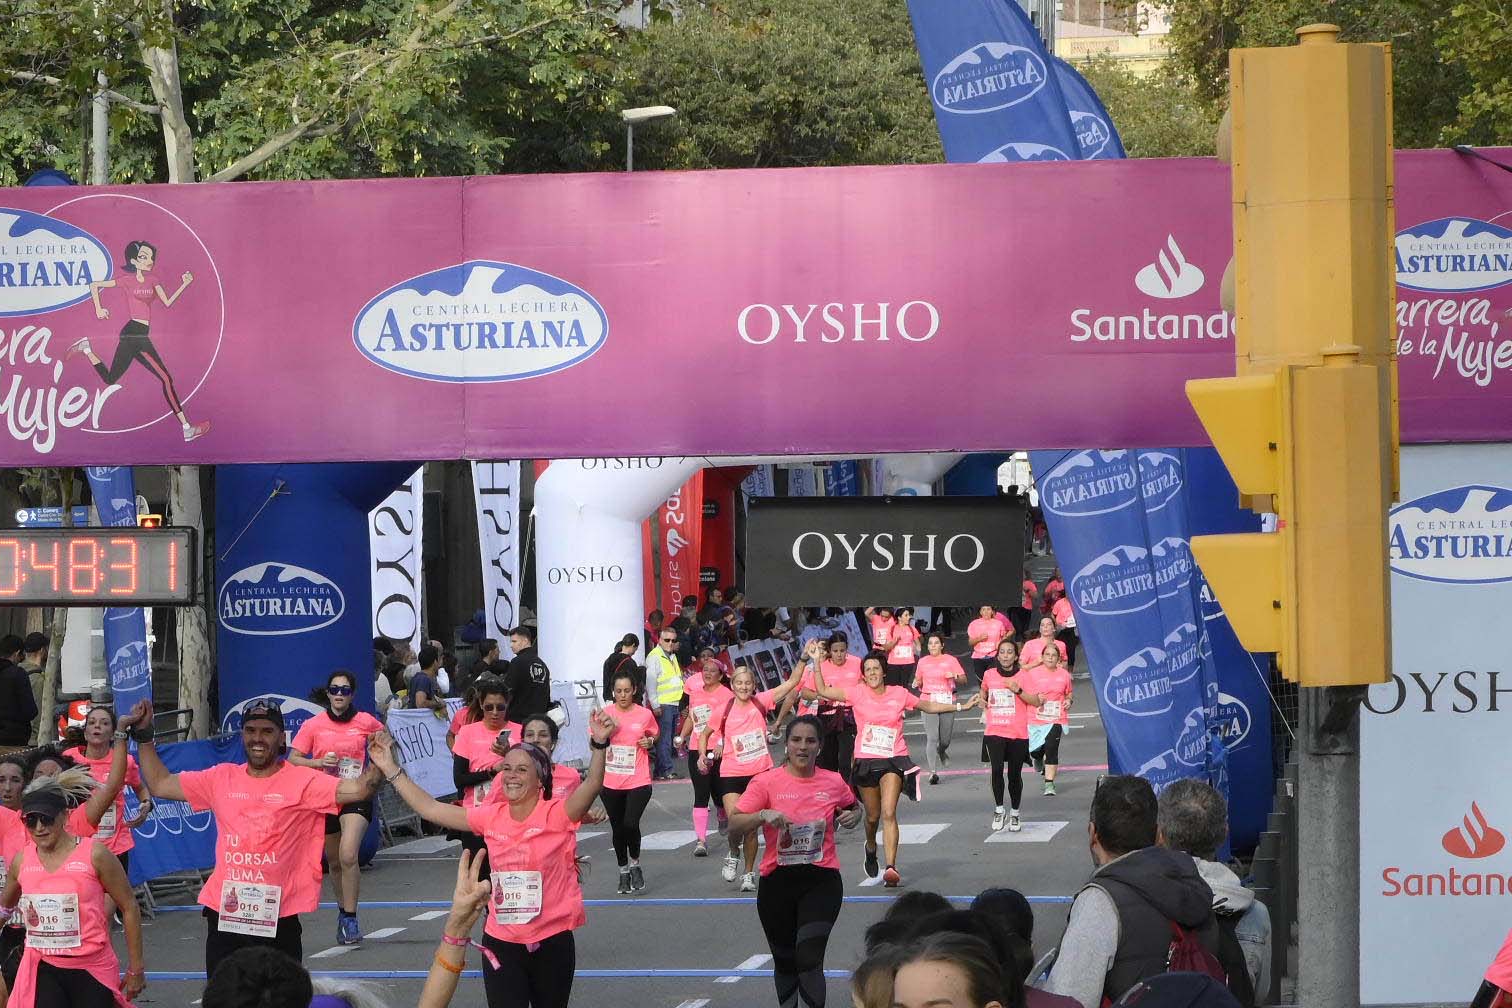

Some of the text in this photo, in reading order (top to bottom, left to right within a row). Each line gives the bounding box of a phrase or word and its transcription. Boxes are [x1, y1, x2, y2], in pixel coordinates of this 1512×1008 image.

[16, 245, 88, 255] LECHERA
[1409, 242, 1512, 251] CENTRAL LECHER
[1395, 246, 1512, 274] ASTURIAN
[412, 302, 580, 316] CENTRAL LECHERA
[1396, 298, 1492, 326] arrera
[372, 308, 588, 352] ASTURIANA
[736, 300, 940, 345] OYSHO
[1419, 329, 1437, 356] la
[1433, 326, 1512, 386] Muje
[1417, 520, 1484, 529] CENTRAL
[792, 532, 985, 572] OYSHO
[548, 565, 623, 584] OYSHO
[282, 586, 331, 595] LECHERA
[223, 592, 335, 620] ASTURIANA
[225, 834, 238, 847] TU
[225, 852, 278, 865] DORSAL
[226, 869, 264, 881] SUMA
[240, 903, 259, 911] 016
